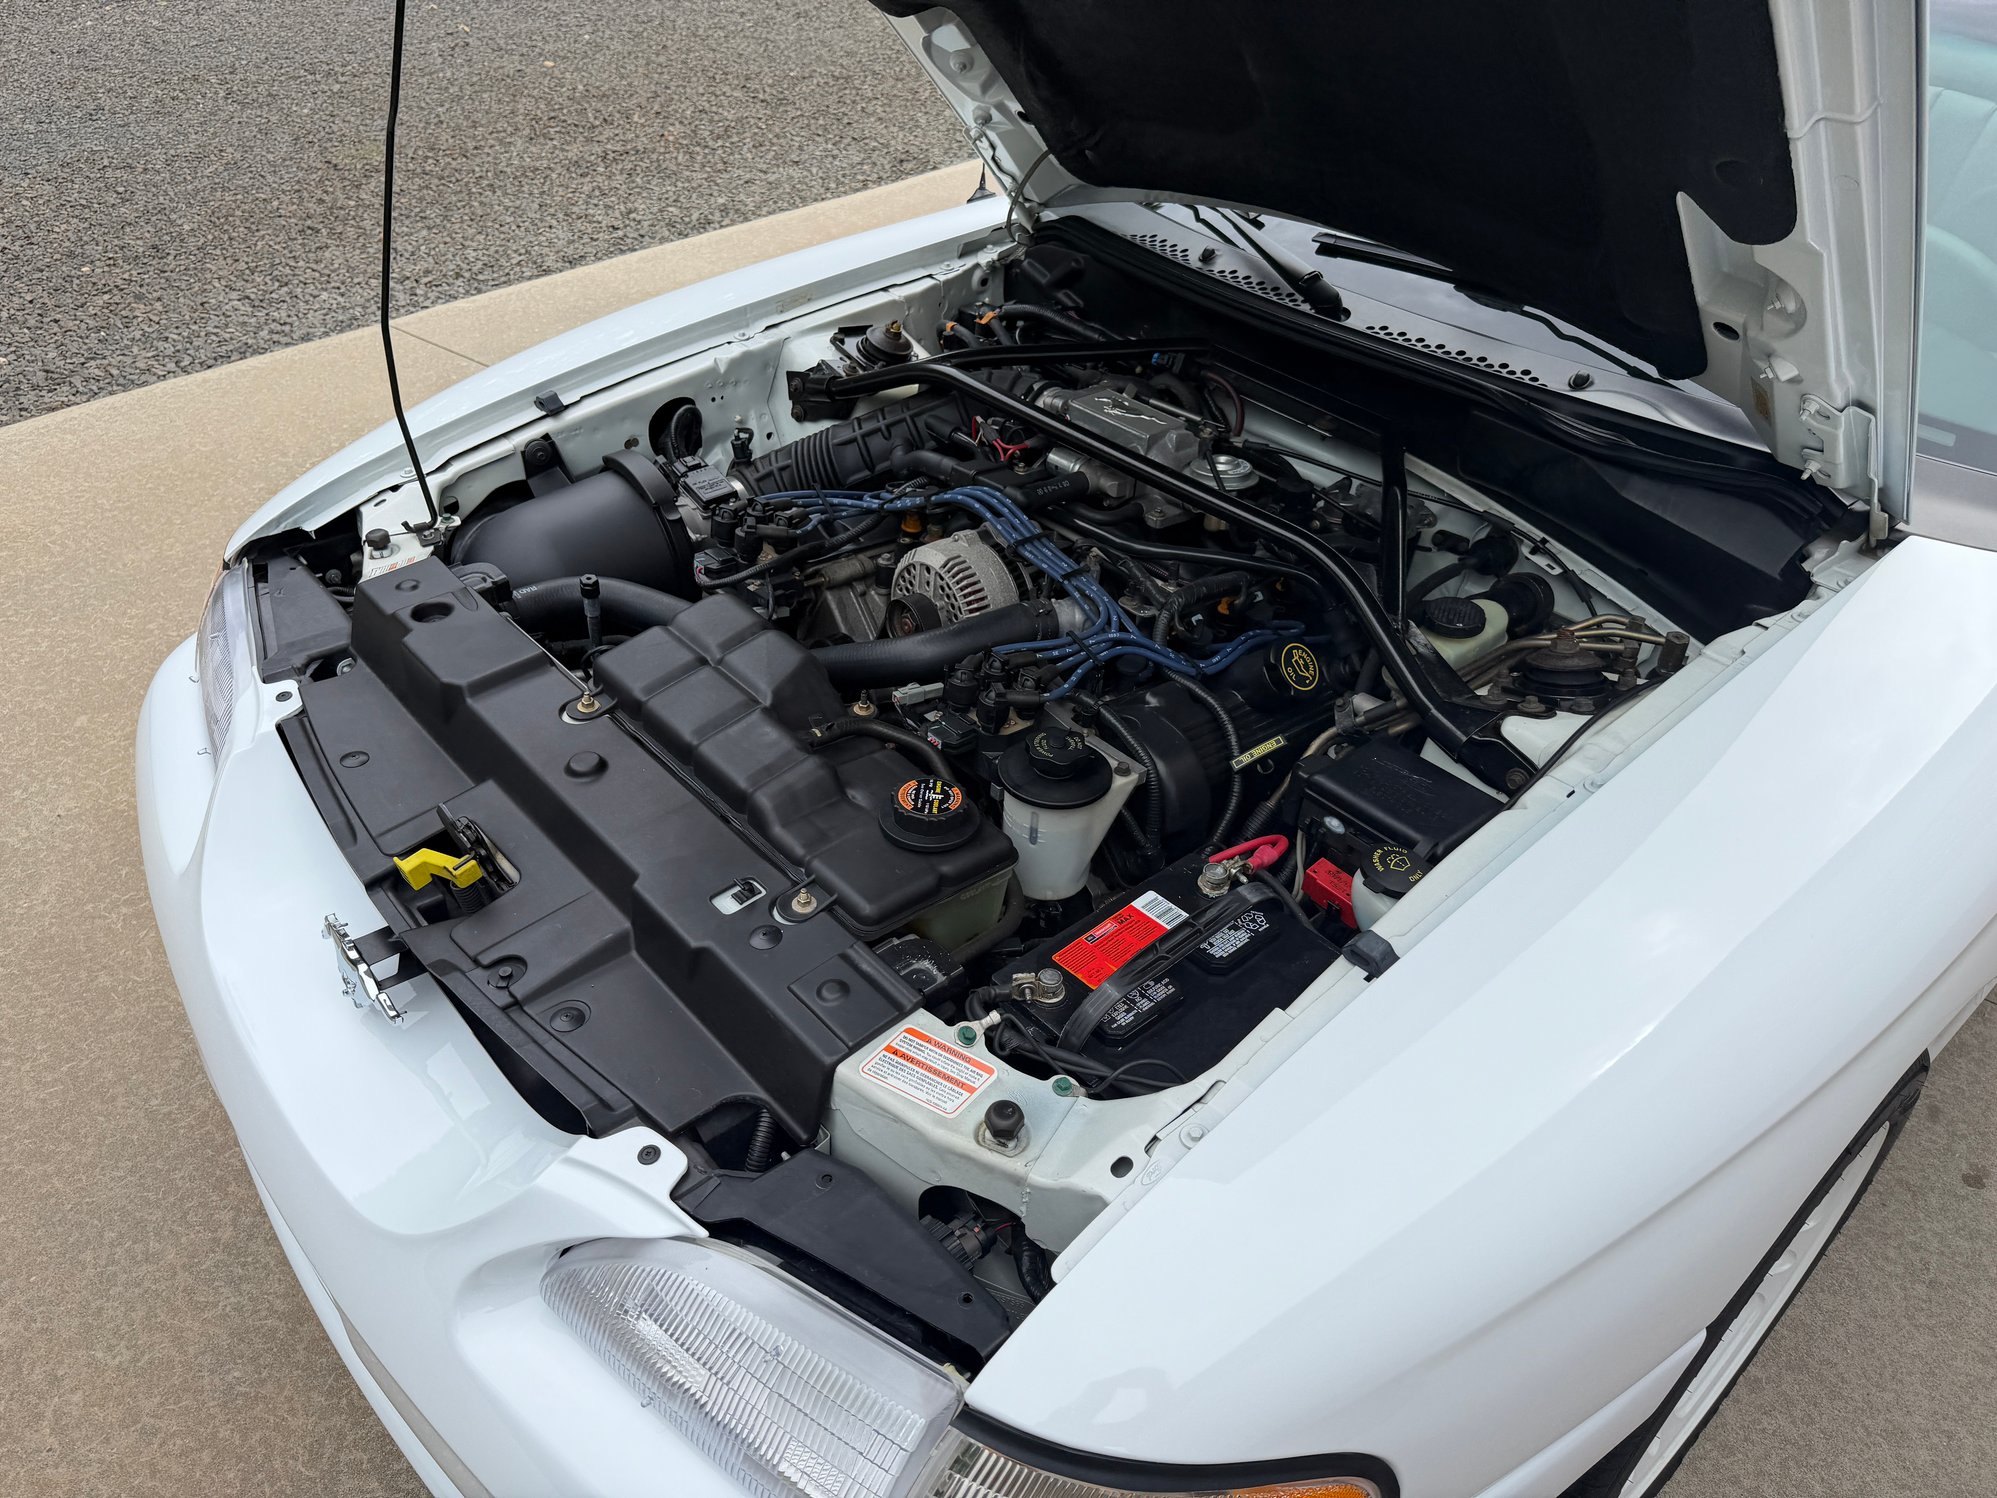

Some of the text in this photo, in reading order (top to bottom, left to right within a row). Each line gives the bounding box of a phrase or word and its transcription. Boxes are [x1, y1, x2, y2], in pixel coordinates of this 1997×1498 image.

[1288, 667, 1296, 680] OIL
[1298, 650, 1314, 676] ENGINE
[1240, 740, 1276, 763] ENGINE OIL
[1373, 849, 1384, 872] WASHER
[1408, 870, 1423, 882] ONLY
[1118, 913, 1134, 925] MAX
[933, 1040, 972, 1063] WARNING
[900, 1053, 964, 1088] AVERTISSEMENT
